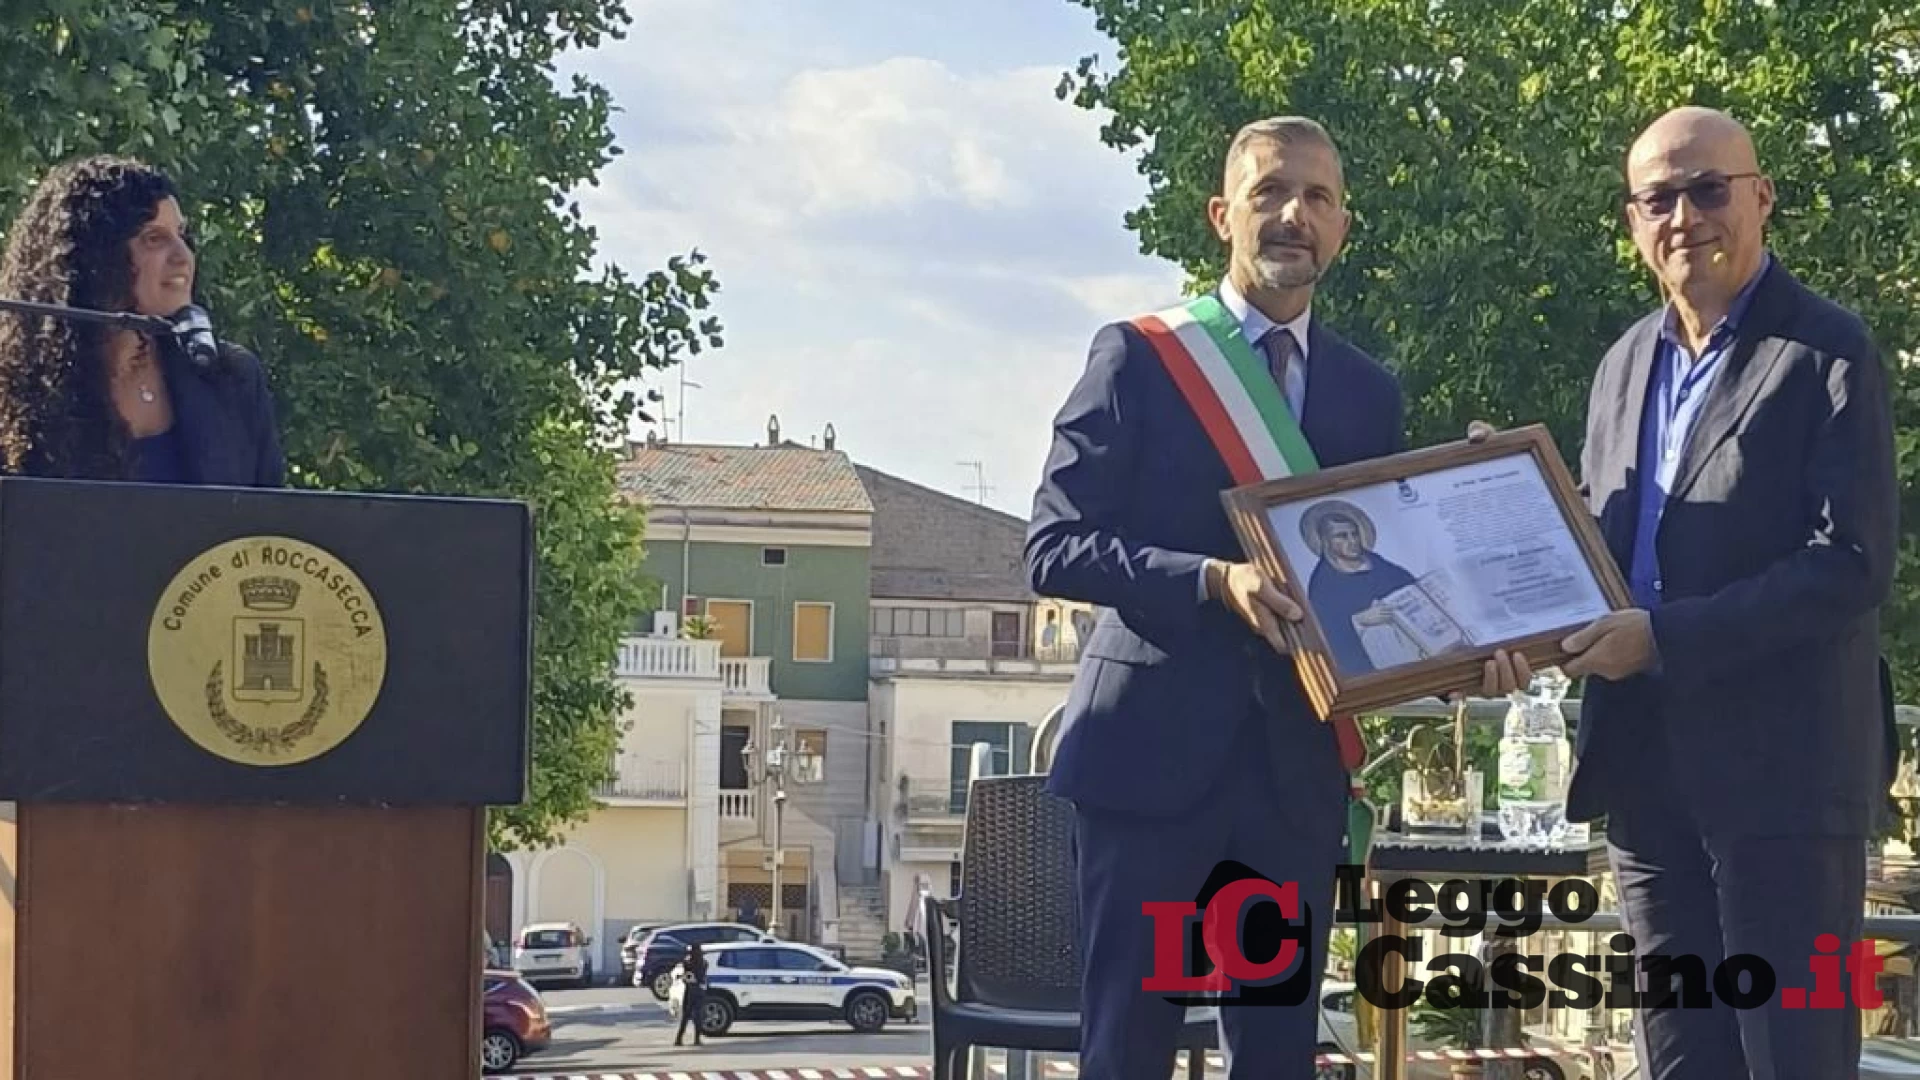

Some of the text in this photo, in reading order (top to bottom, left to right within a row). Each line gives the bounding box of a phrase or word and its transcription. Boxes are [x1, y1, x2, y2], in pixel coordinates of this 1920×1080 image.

[163, 546, 372, 638] Comune di ROCCASECCA
